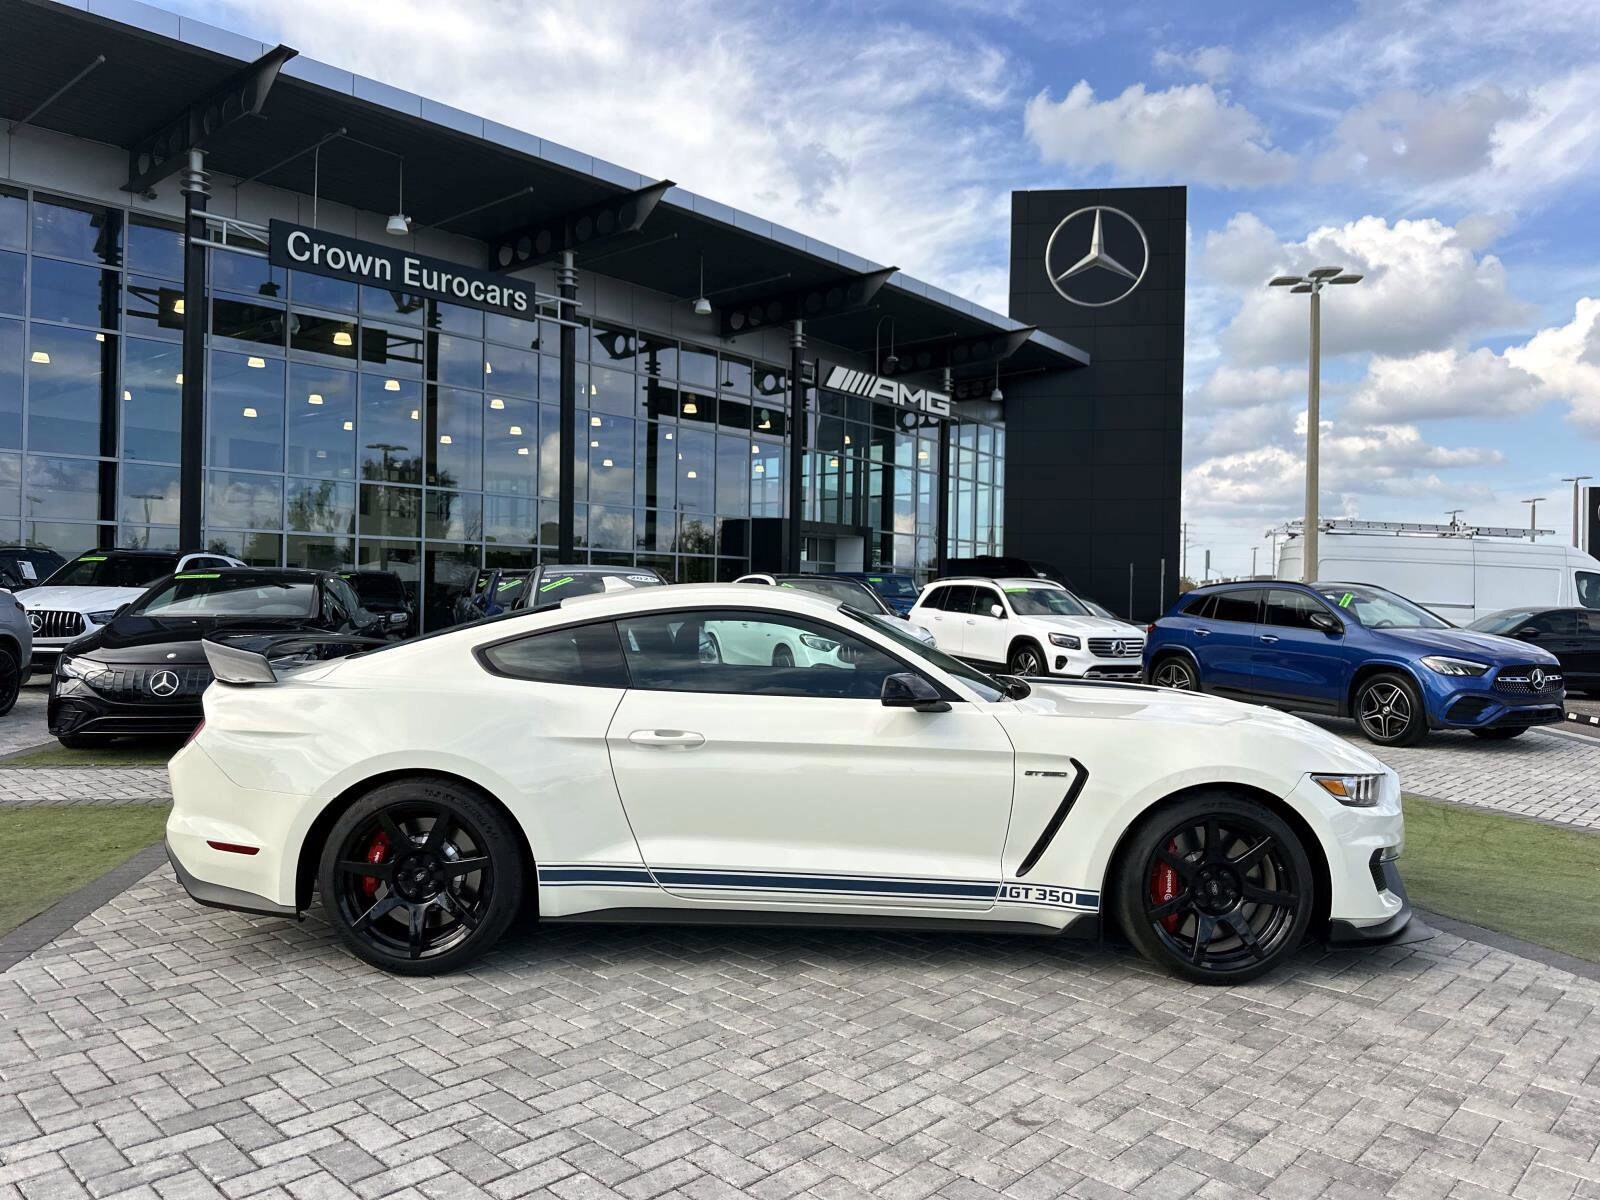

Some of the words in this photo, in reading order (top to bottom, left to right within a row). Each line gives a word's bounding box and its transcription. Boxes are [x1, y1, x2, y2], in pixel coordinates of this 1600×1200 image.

[287, 231, 392, 281] Crown
[403, 257, 528, 312] Eurocars
[869, 377, 950, 417] AMG
